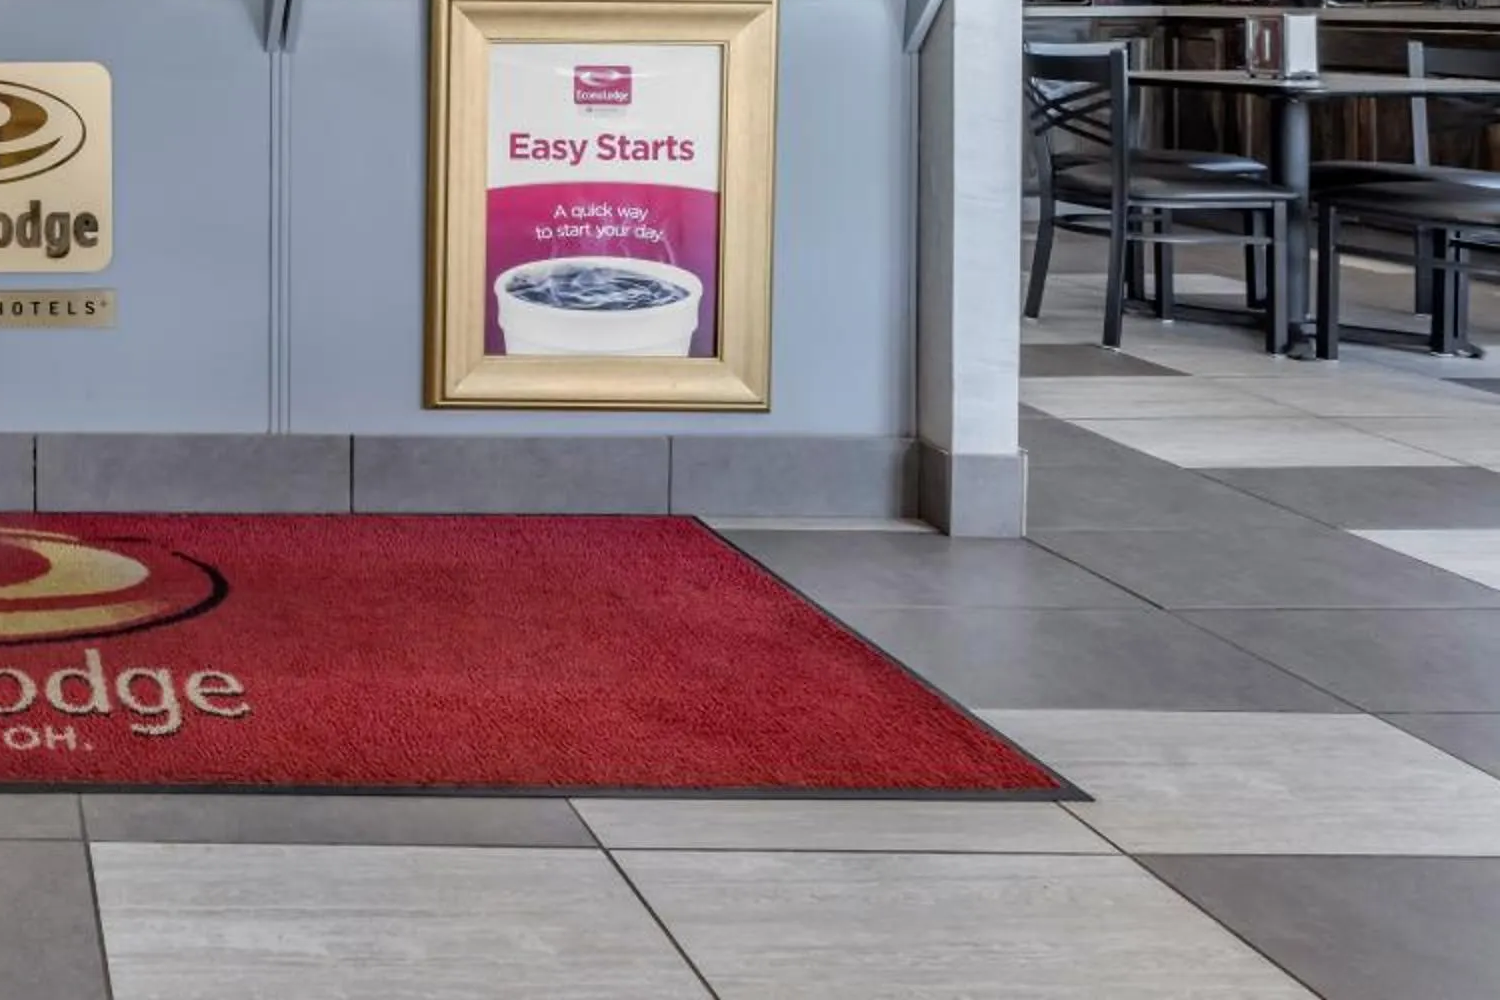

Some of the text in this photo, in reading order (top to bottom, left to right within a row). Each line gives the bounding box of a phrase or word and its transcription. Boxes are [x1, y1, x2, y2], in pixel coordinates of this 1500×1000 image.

[509, 132, 694, 165] Easy Starts
[554, 201, 649, 220] A quick way
[536, 227, 553, 240] to
[557, 222, 591, 237] start
[596, 223, 631, 238] your
[3, 726, 94, 751] OH.
